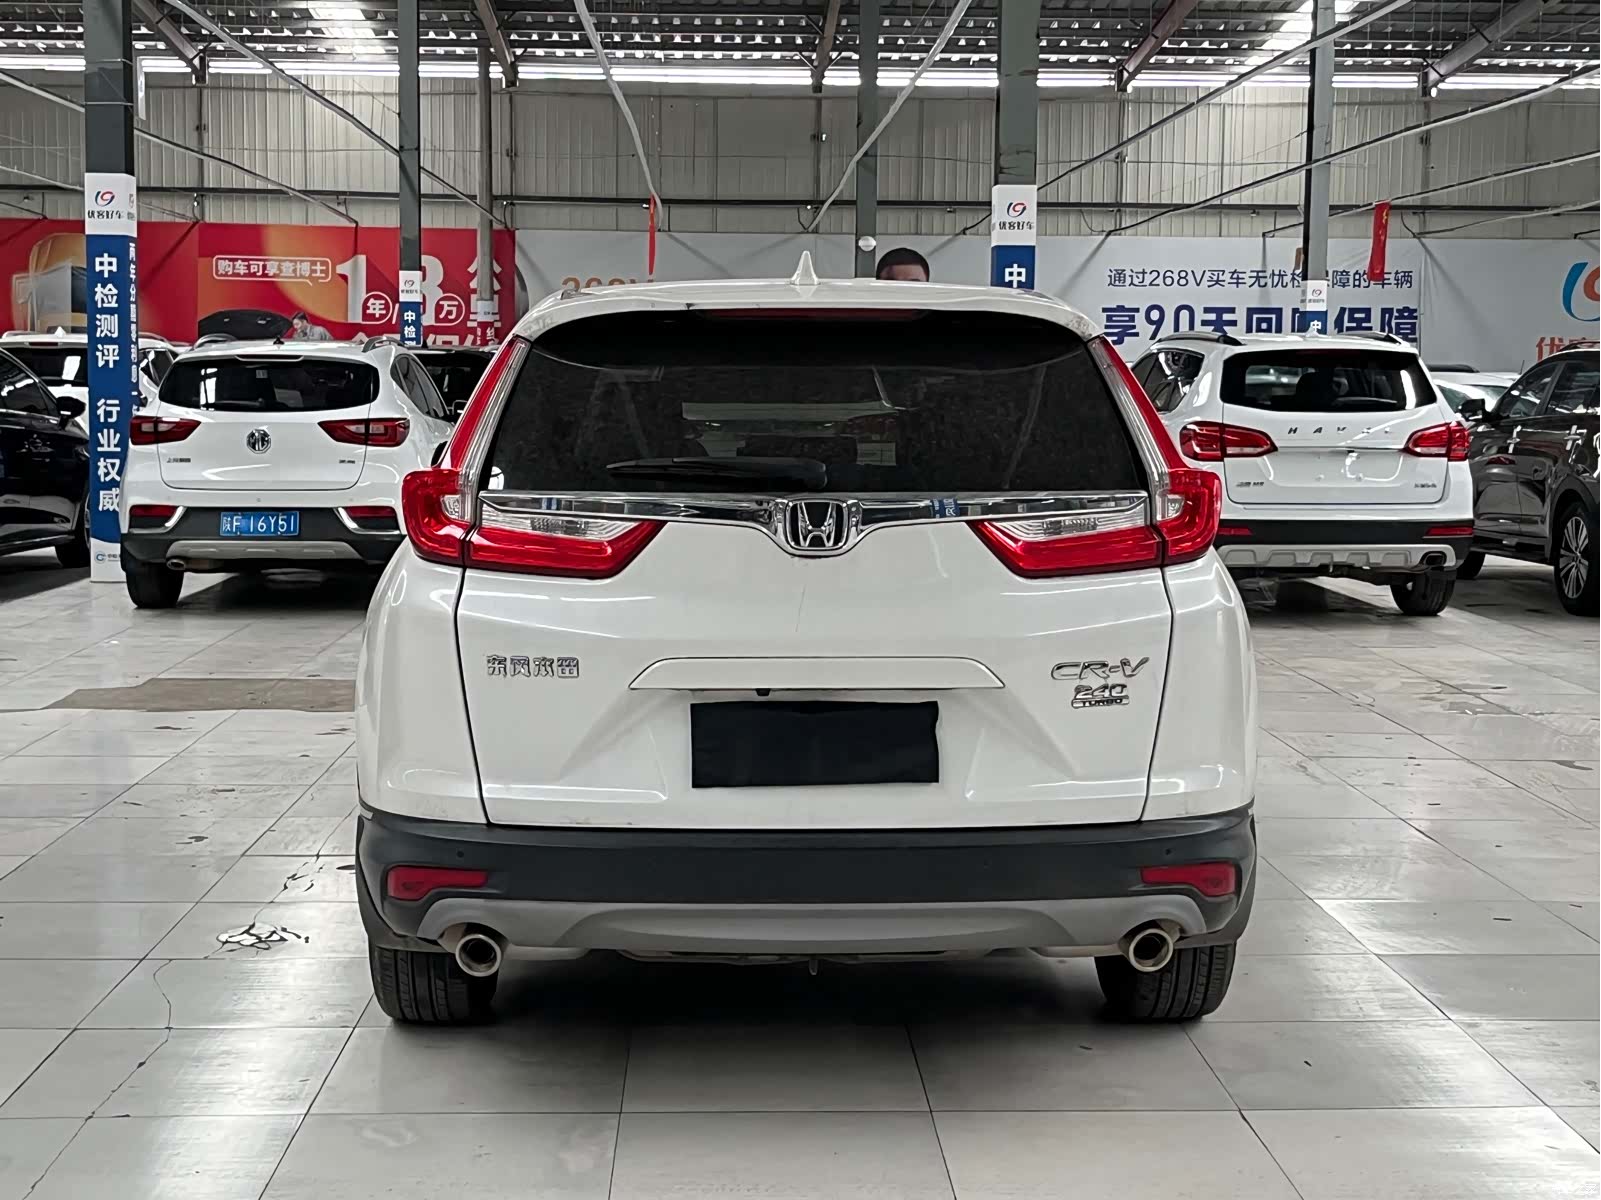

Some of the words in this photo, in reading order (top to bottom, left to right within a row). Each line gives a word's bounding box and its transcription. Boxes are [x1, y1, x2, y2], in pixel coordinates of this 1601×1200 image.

[217, 260, 327, 277] 购车可享查博士
[1005, 263, 1026, 289] 中
[1107, 269, 1414, 289] 通过268V买车无忧检障的车辆
[95, 253, 120, 369] 中检测评
[97, 398, 121, 512] 行业权威
[1051, 657, 1150, 681] CR-V
